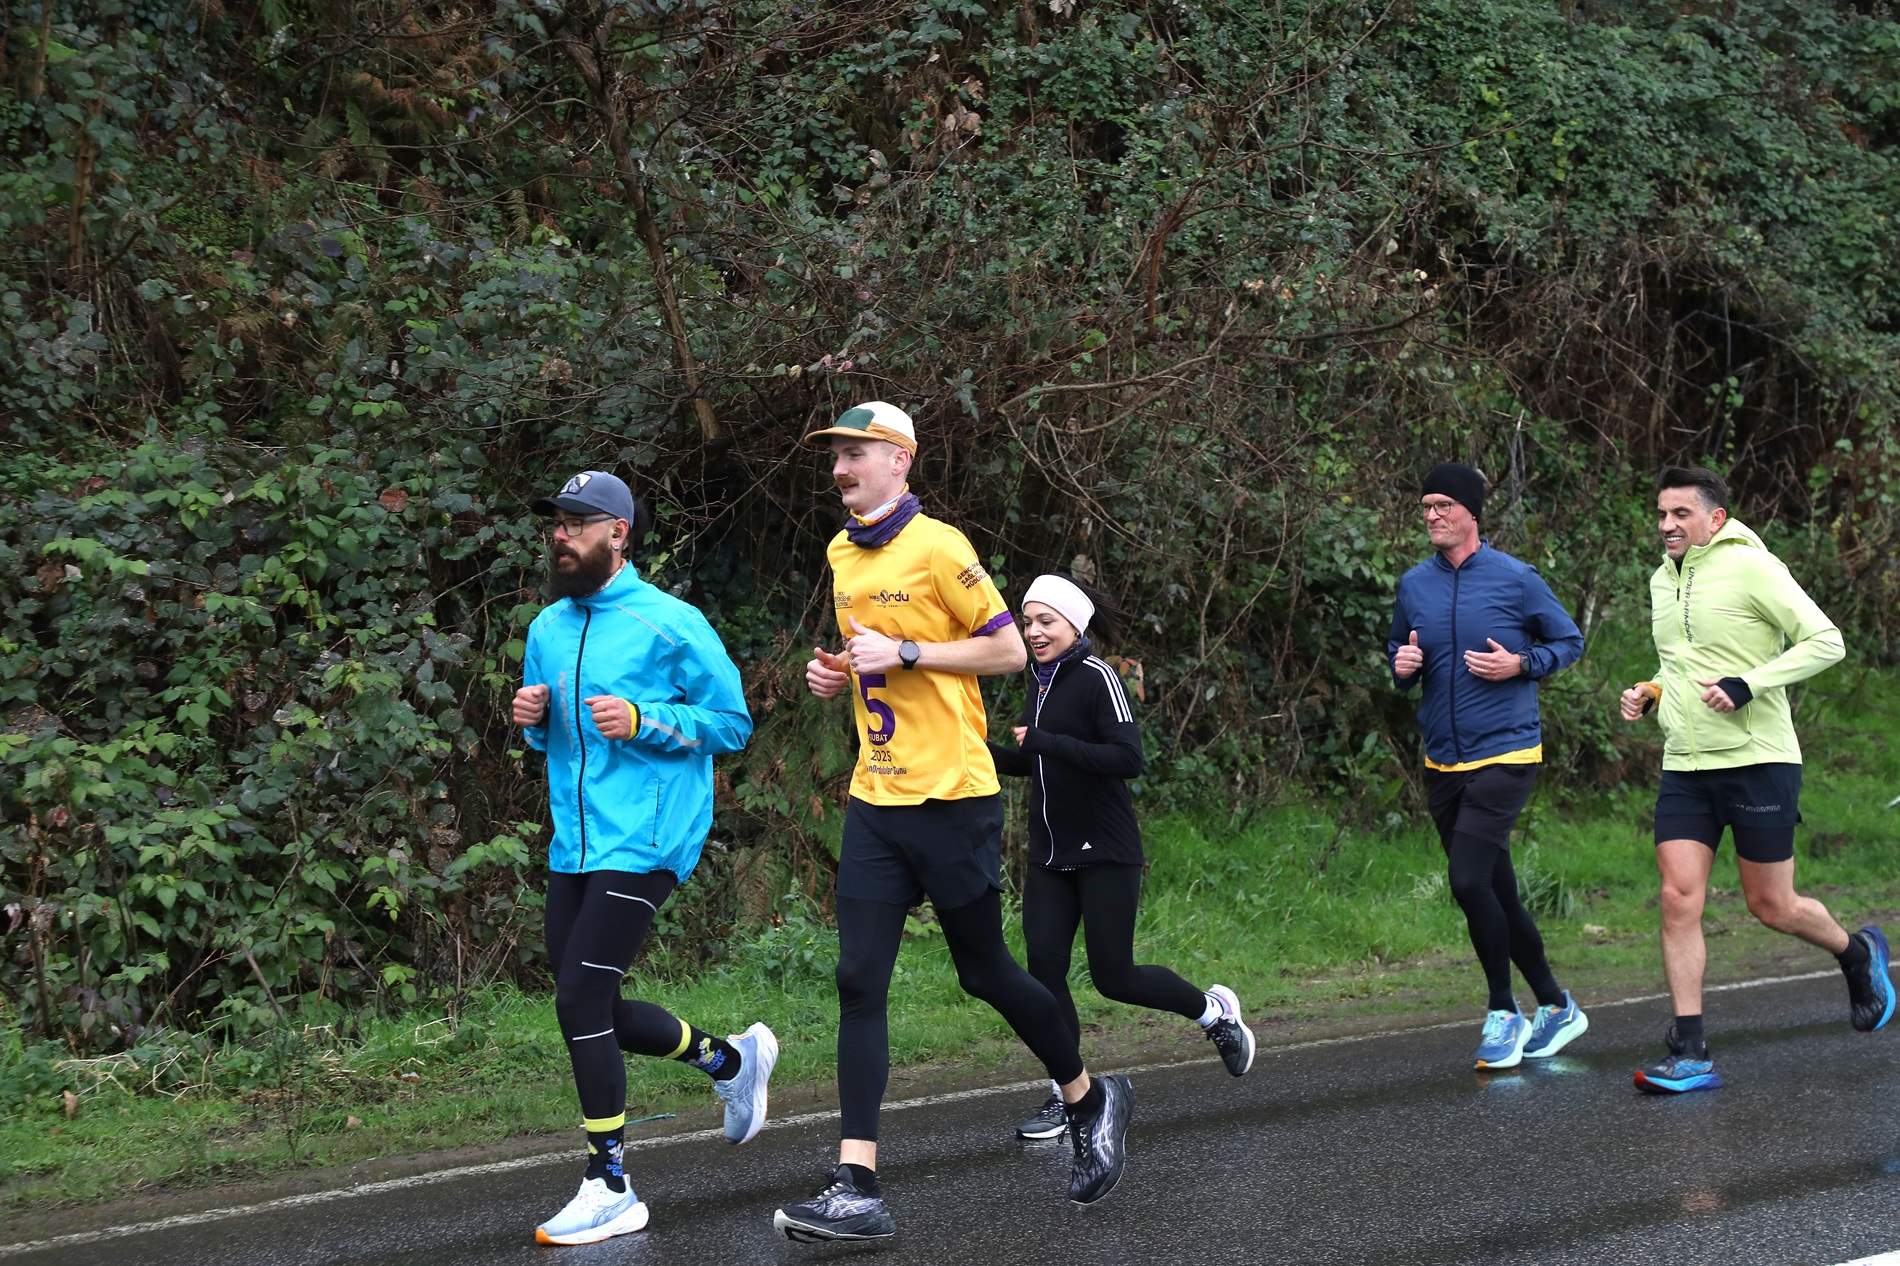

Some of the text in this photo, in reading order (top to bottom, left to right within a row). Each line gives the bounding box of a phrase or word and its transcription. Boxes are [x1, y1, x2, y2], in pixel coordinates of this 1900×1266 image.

[1685, 566, 1695, 600] UNDER
[859, 673, 896, 746] 5
[870, 749, 892, 762] 2025
